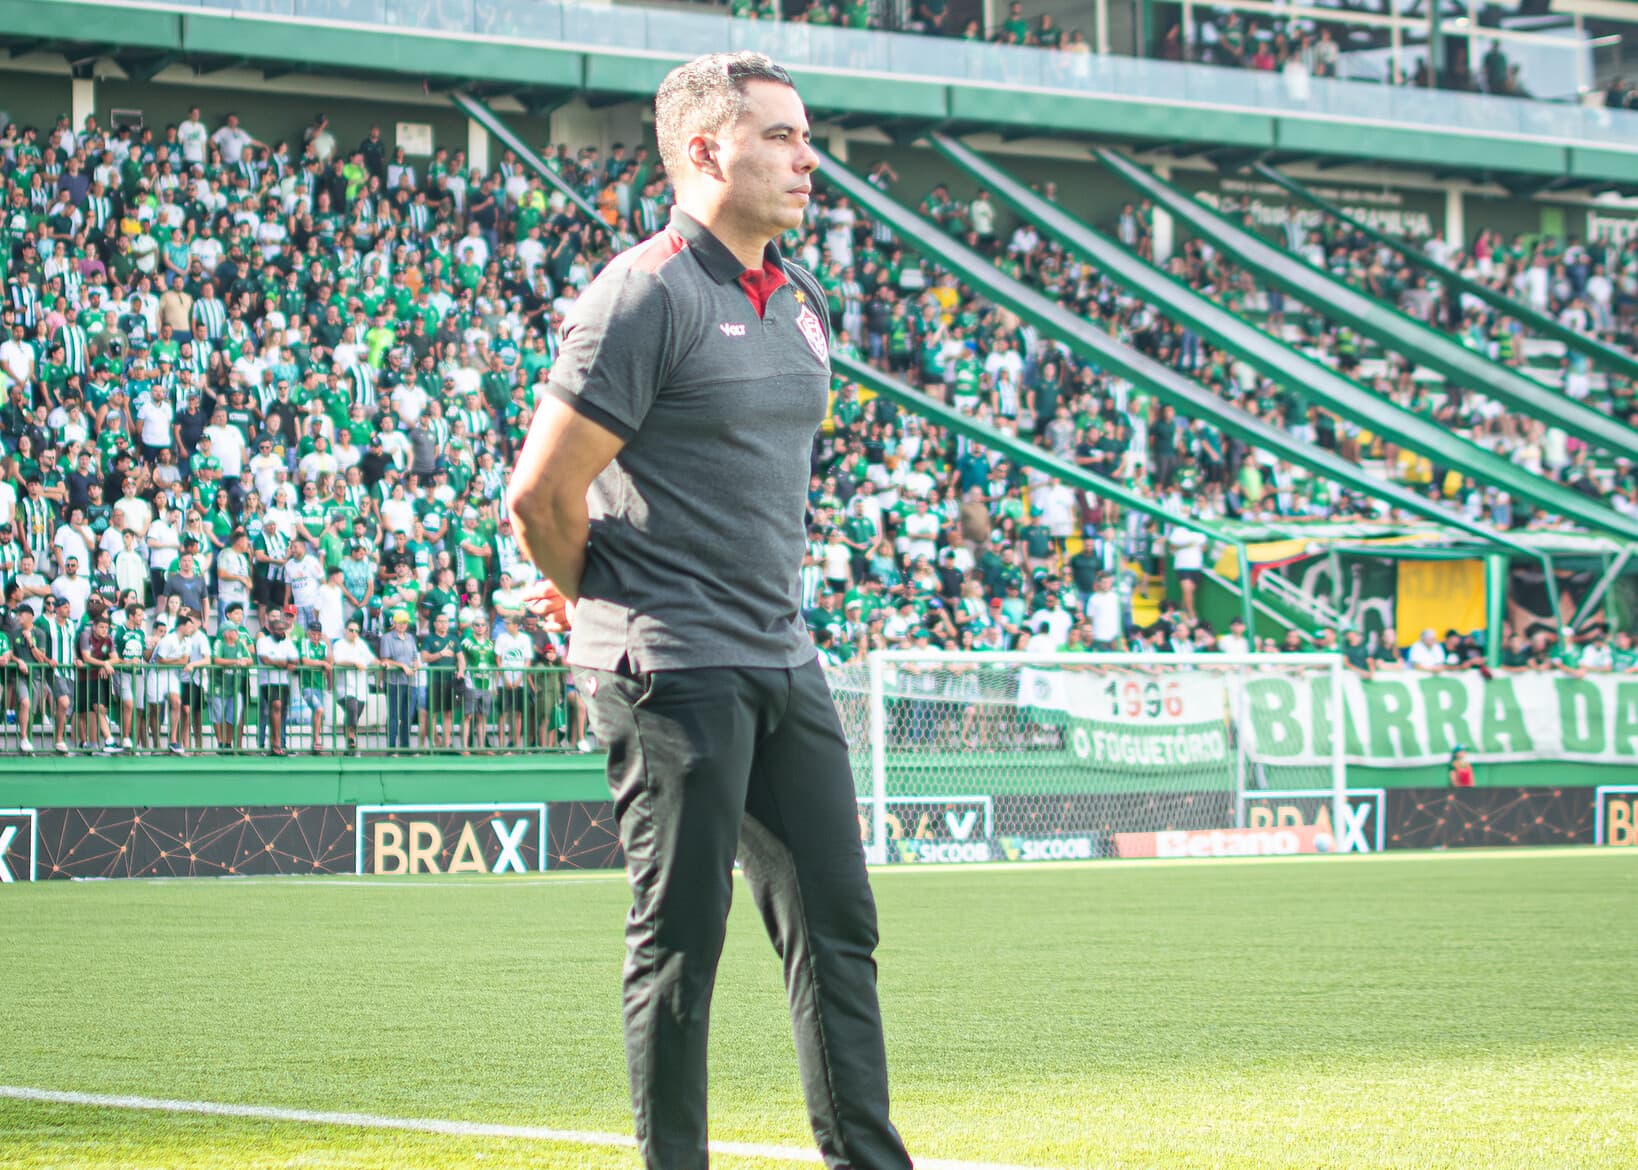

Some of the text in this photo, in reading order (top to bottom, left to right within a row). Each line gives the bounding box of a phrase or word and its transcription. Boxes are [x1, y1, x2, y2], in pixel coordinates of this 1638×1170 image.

[1105, 680, 1184, 718] 1996
[1245, 675, 1535, 758] BARRA
[1073, 727, 1091, 759] O
[374, 818, 530, 875] BRAX
[1021, 837, 1092, 860] SICOOB
[1155, 829, 1300, 858] Betano
